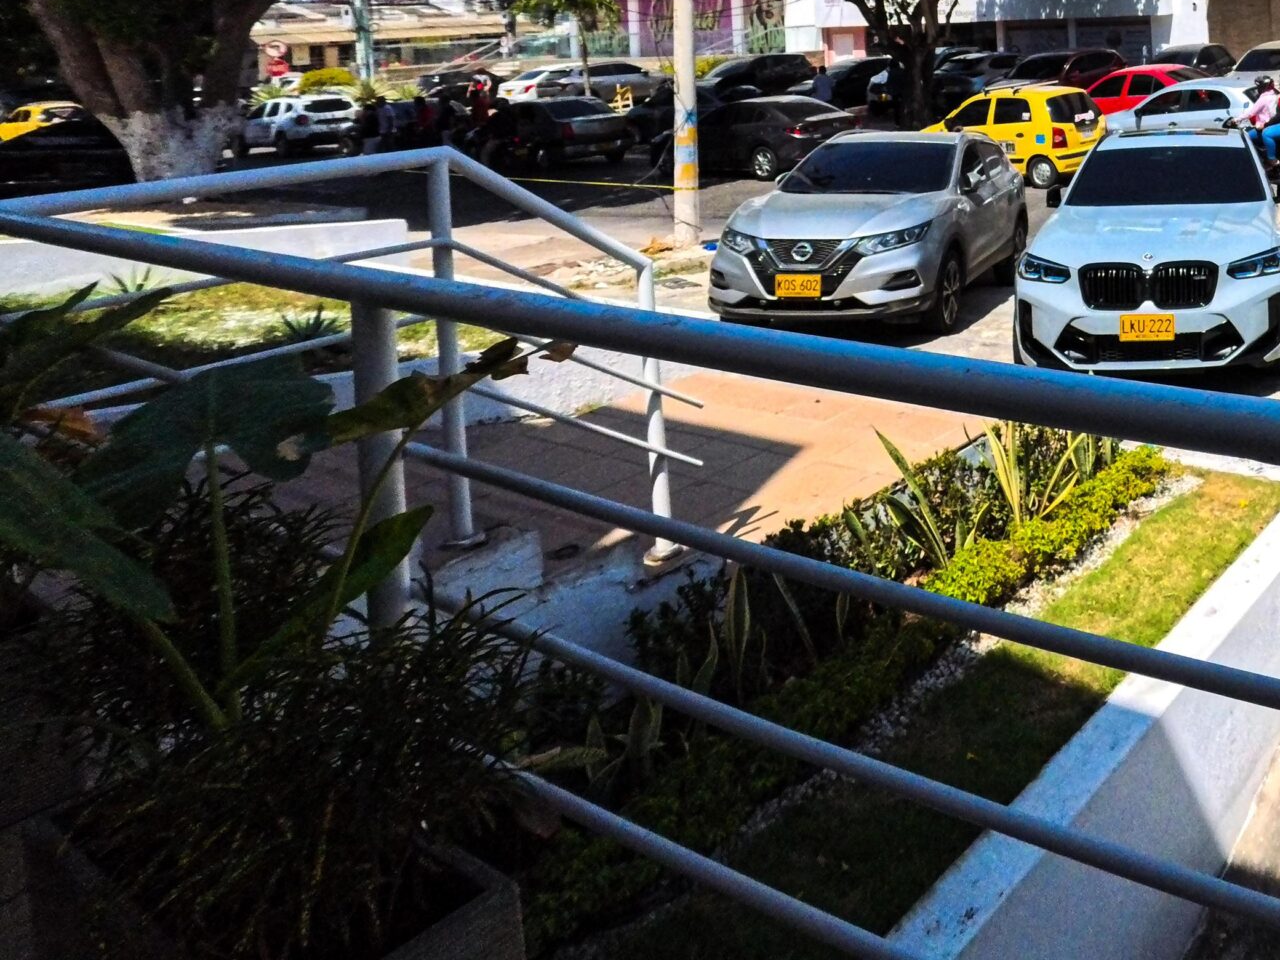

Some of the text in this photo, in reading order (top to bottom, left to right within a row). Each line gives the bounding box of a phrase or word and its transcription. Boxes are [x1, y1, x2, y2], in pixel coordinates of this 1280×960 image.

[799, 279, 819, 292] 602
[1122, 319, 1172, 334] LKU 222
